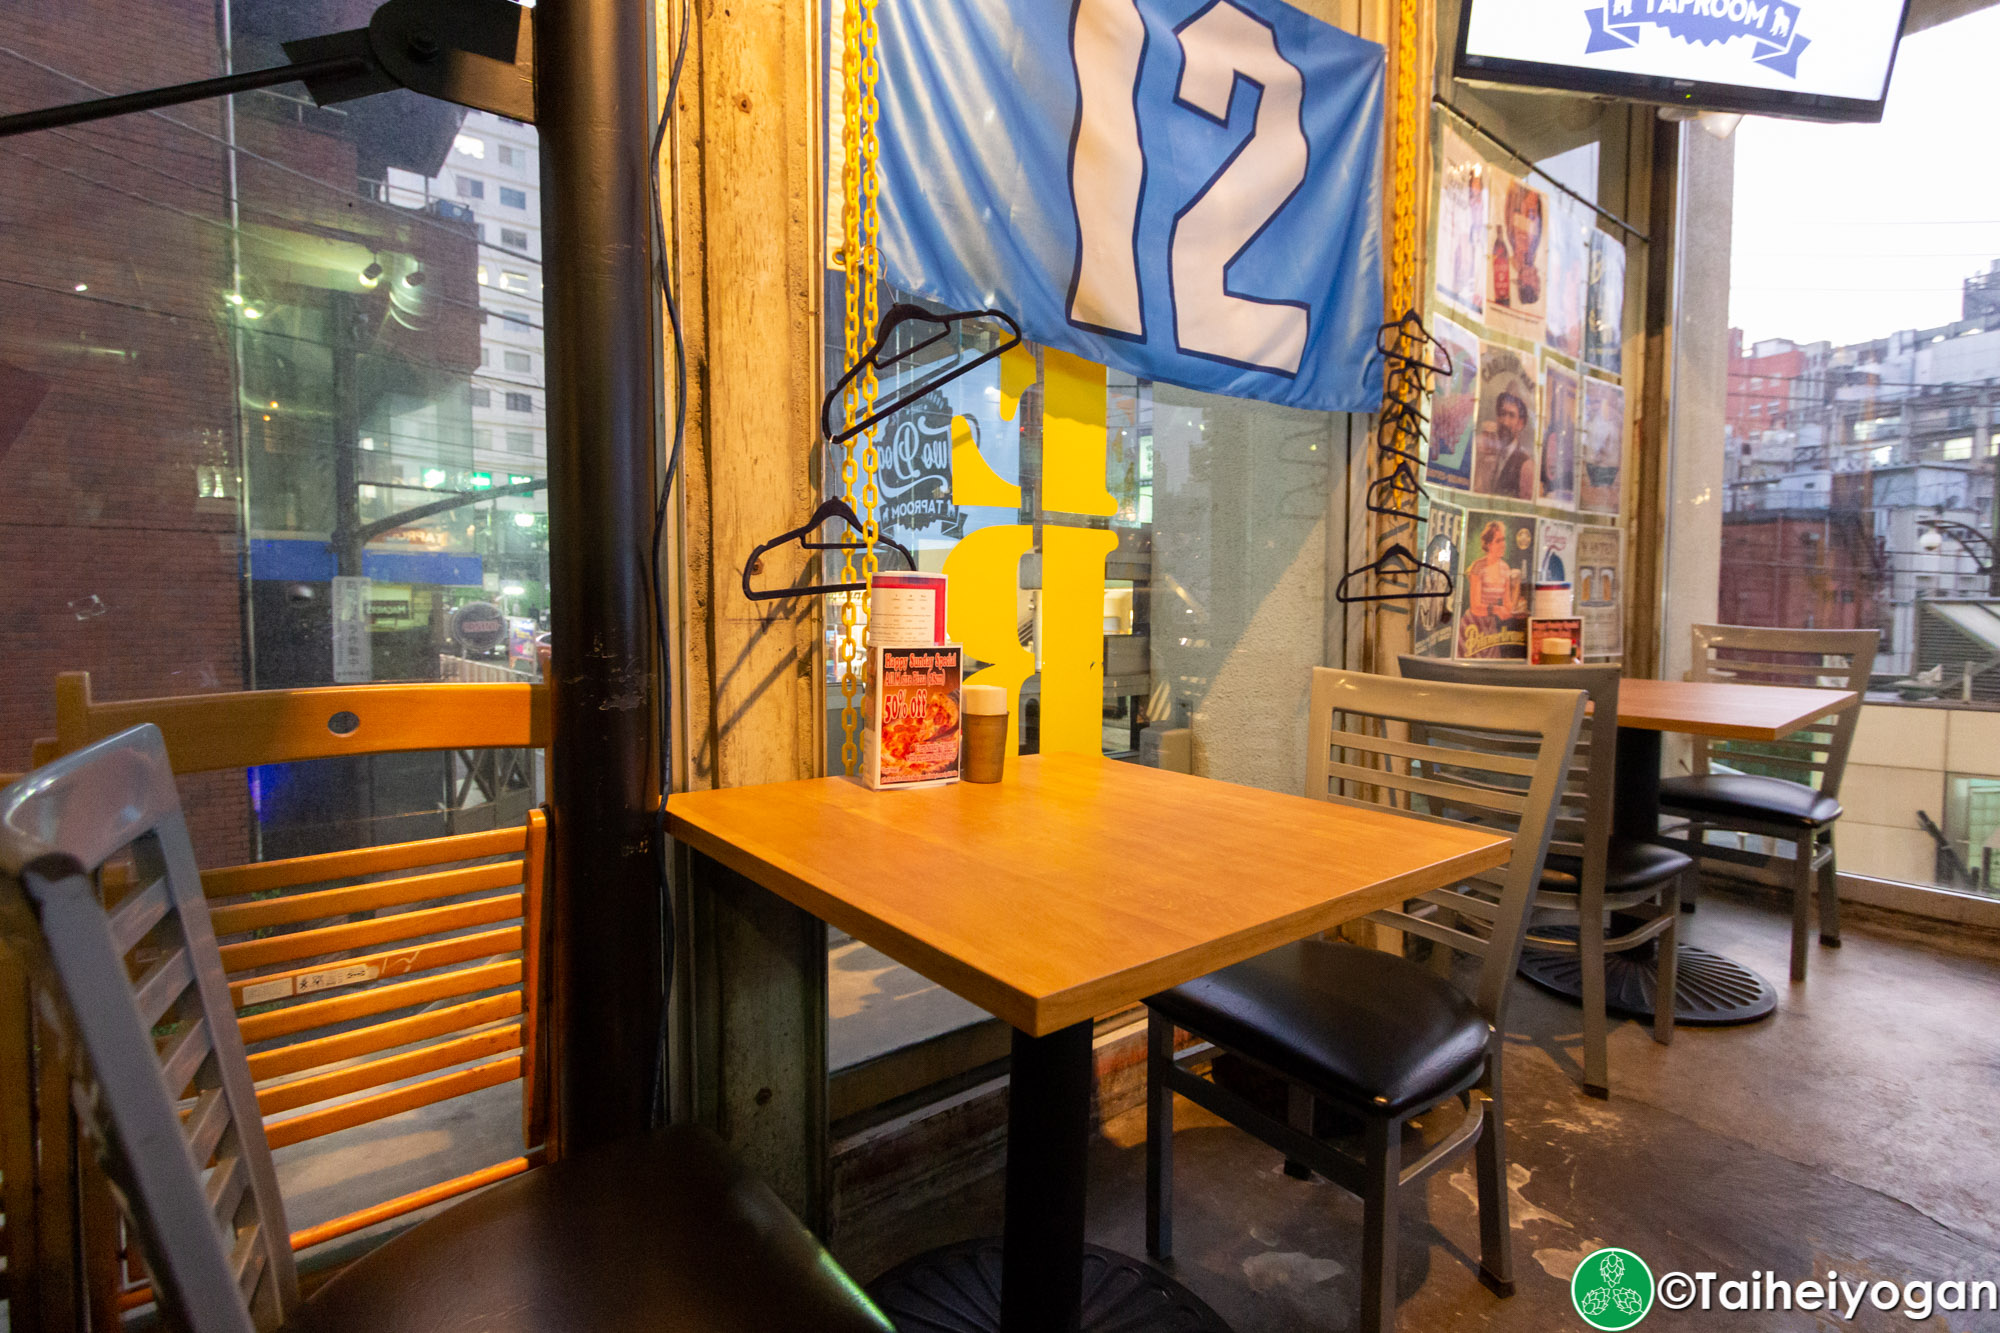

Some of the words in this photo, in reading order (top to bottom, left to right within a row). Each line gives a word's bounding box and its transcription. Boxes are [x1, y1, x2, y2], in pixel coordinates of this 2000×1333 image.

[1645, 0, 1769, 29] TAPROOM
[1065, 0, 1311, 380] 12
[885, 652, 909, 672] Happy
[909, 652, 934, 670] Sunday
[935, 651, 957, 670] Special
[884, 688, 908, 724] 50%
[910, 688, 928, 719] off
